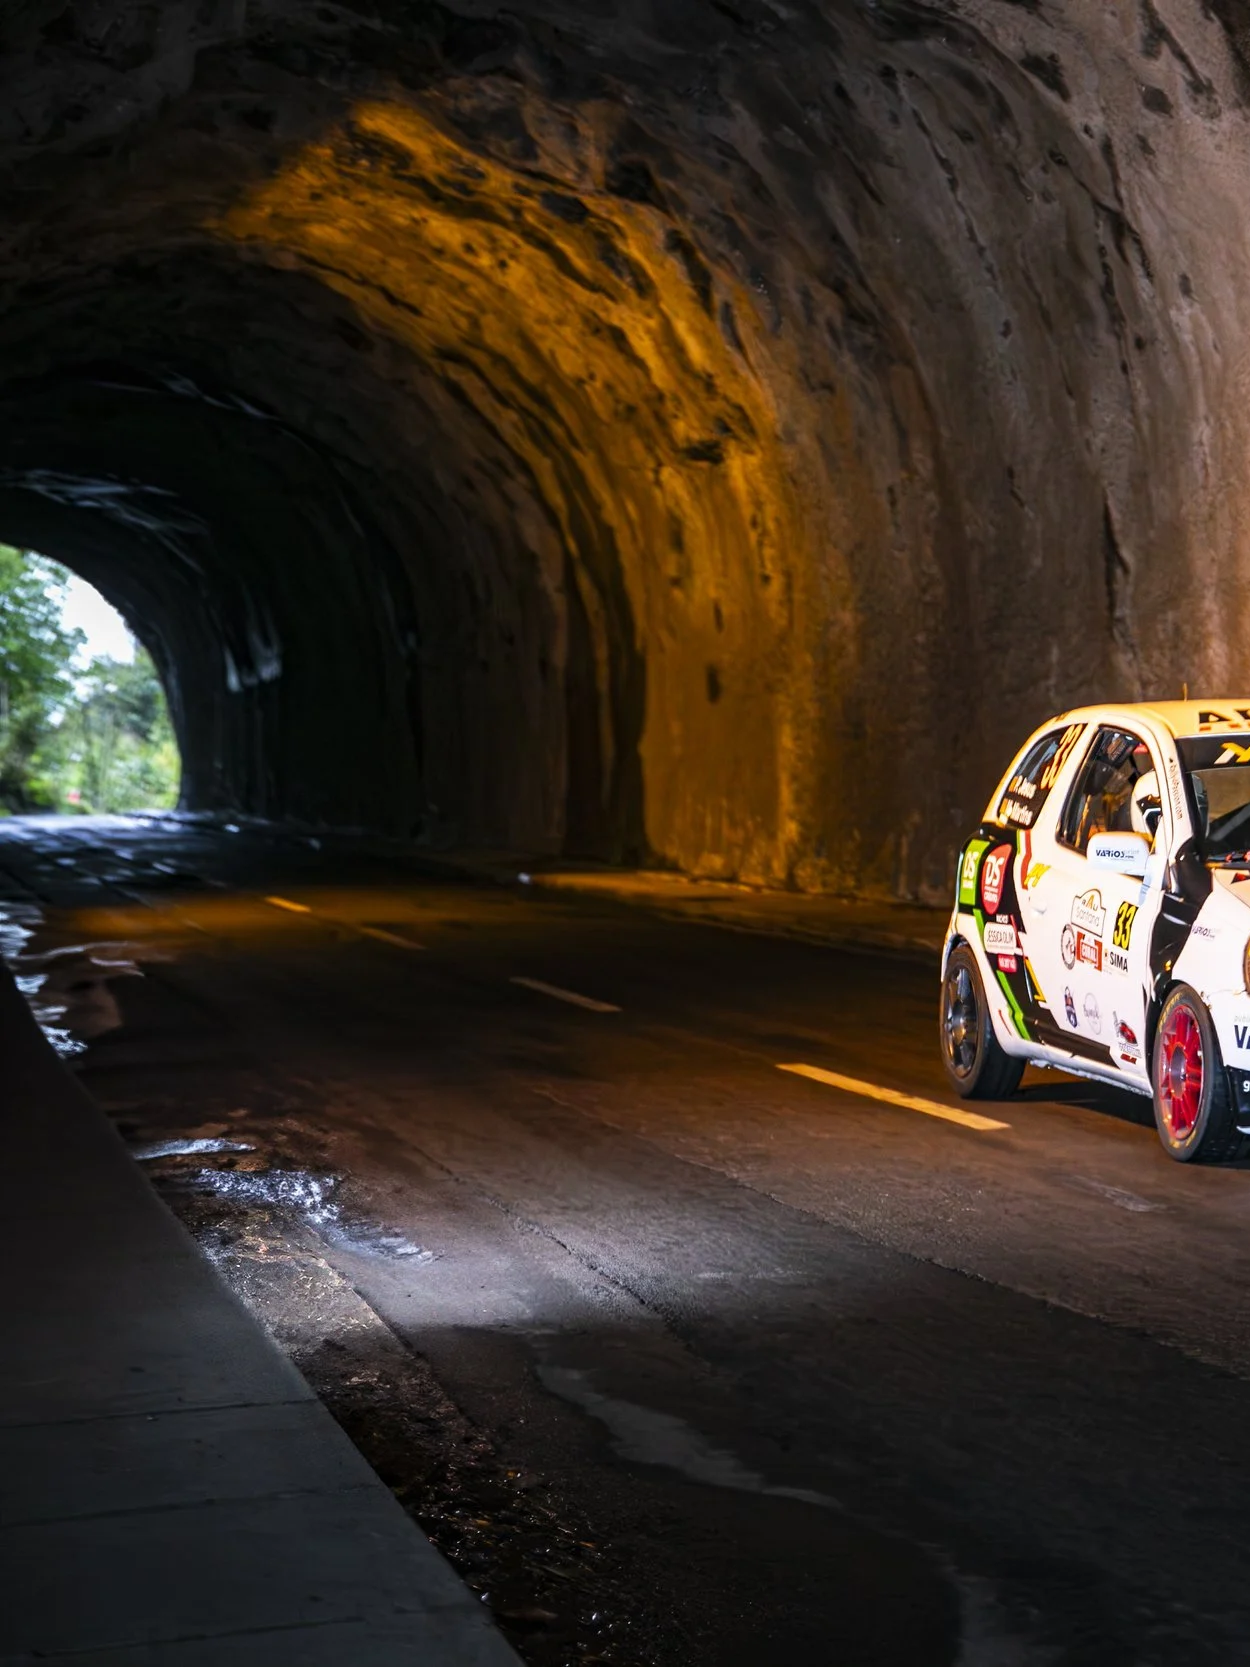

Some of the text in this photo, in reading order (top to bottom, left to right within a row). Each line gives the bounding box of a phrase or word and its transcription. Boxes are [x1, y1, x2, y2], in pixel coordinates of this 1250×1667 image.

[963, 851, 980, 879] DS
[984, 855, 1005, 887] DS
[1113, 902, 1137, 949] 33
[1109, 951, 1129, 972] SIMA
